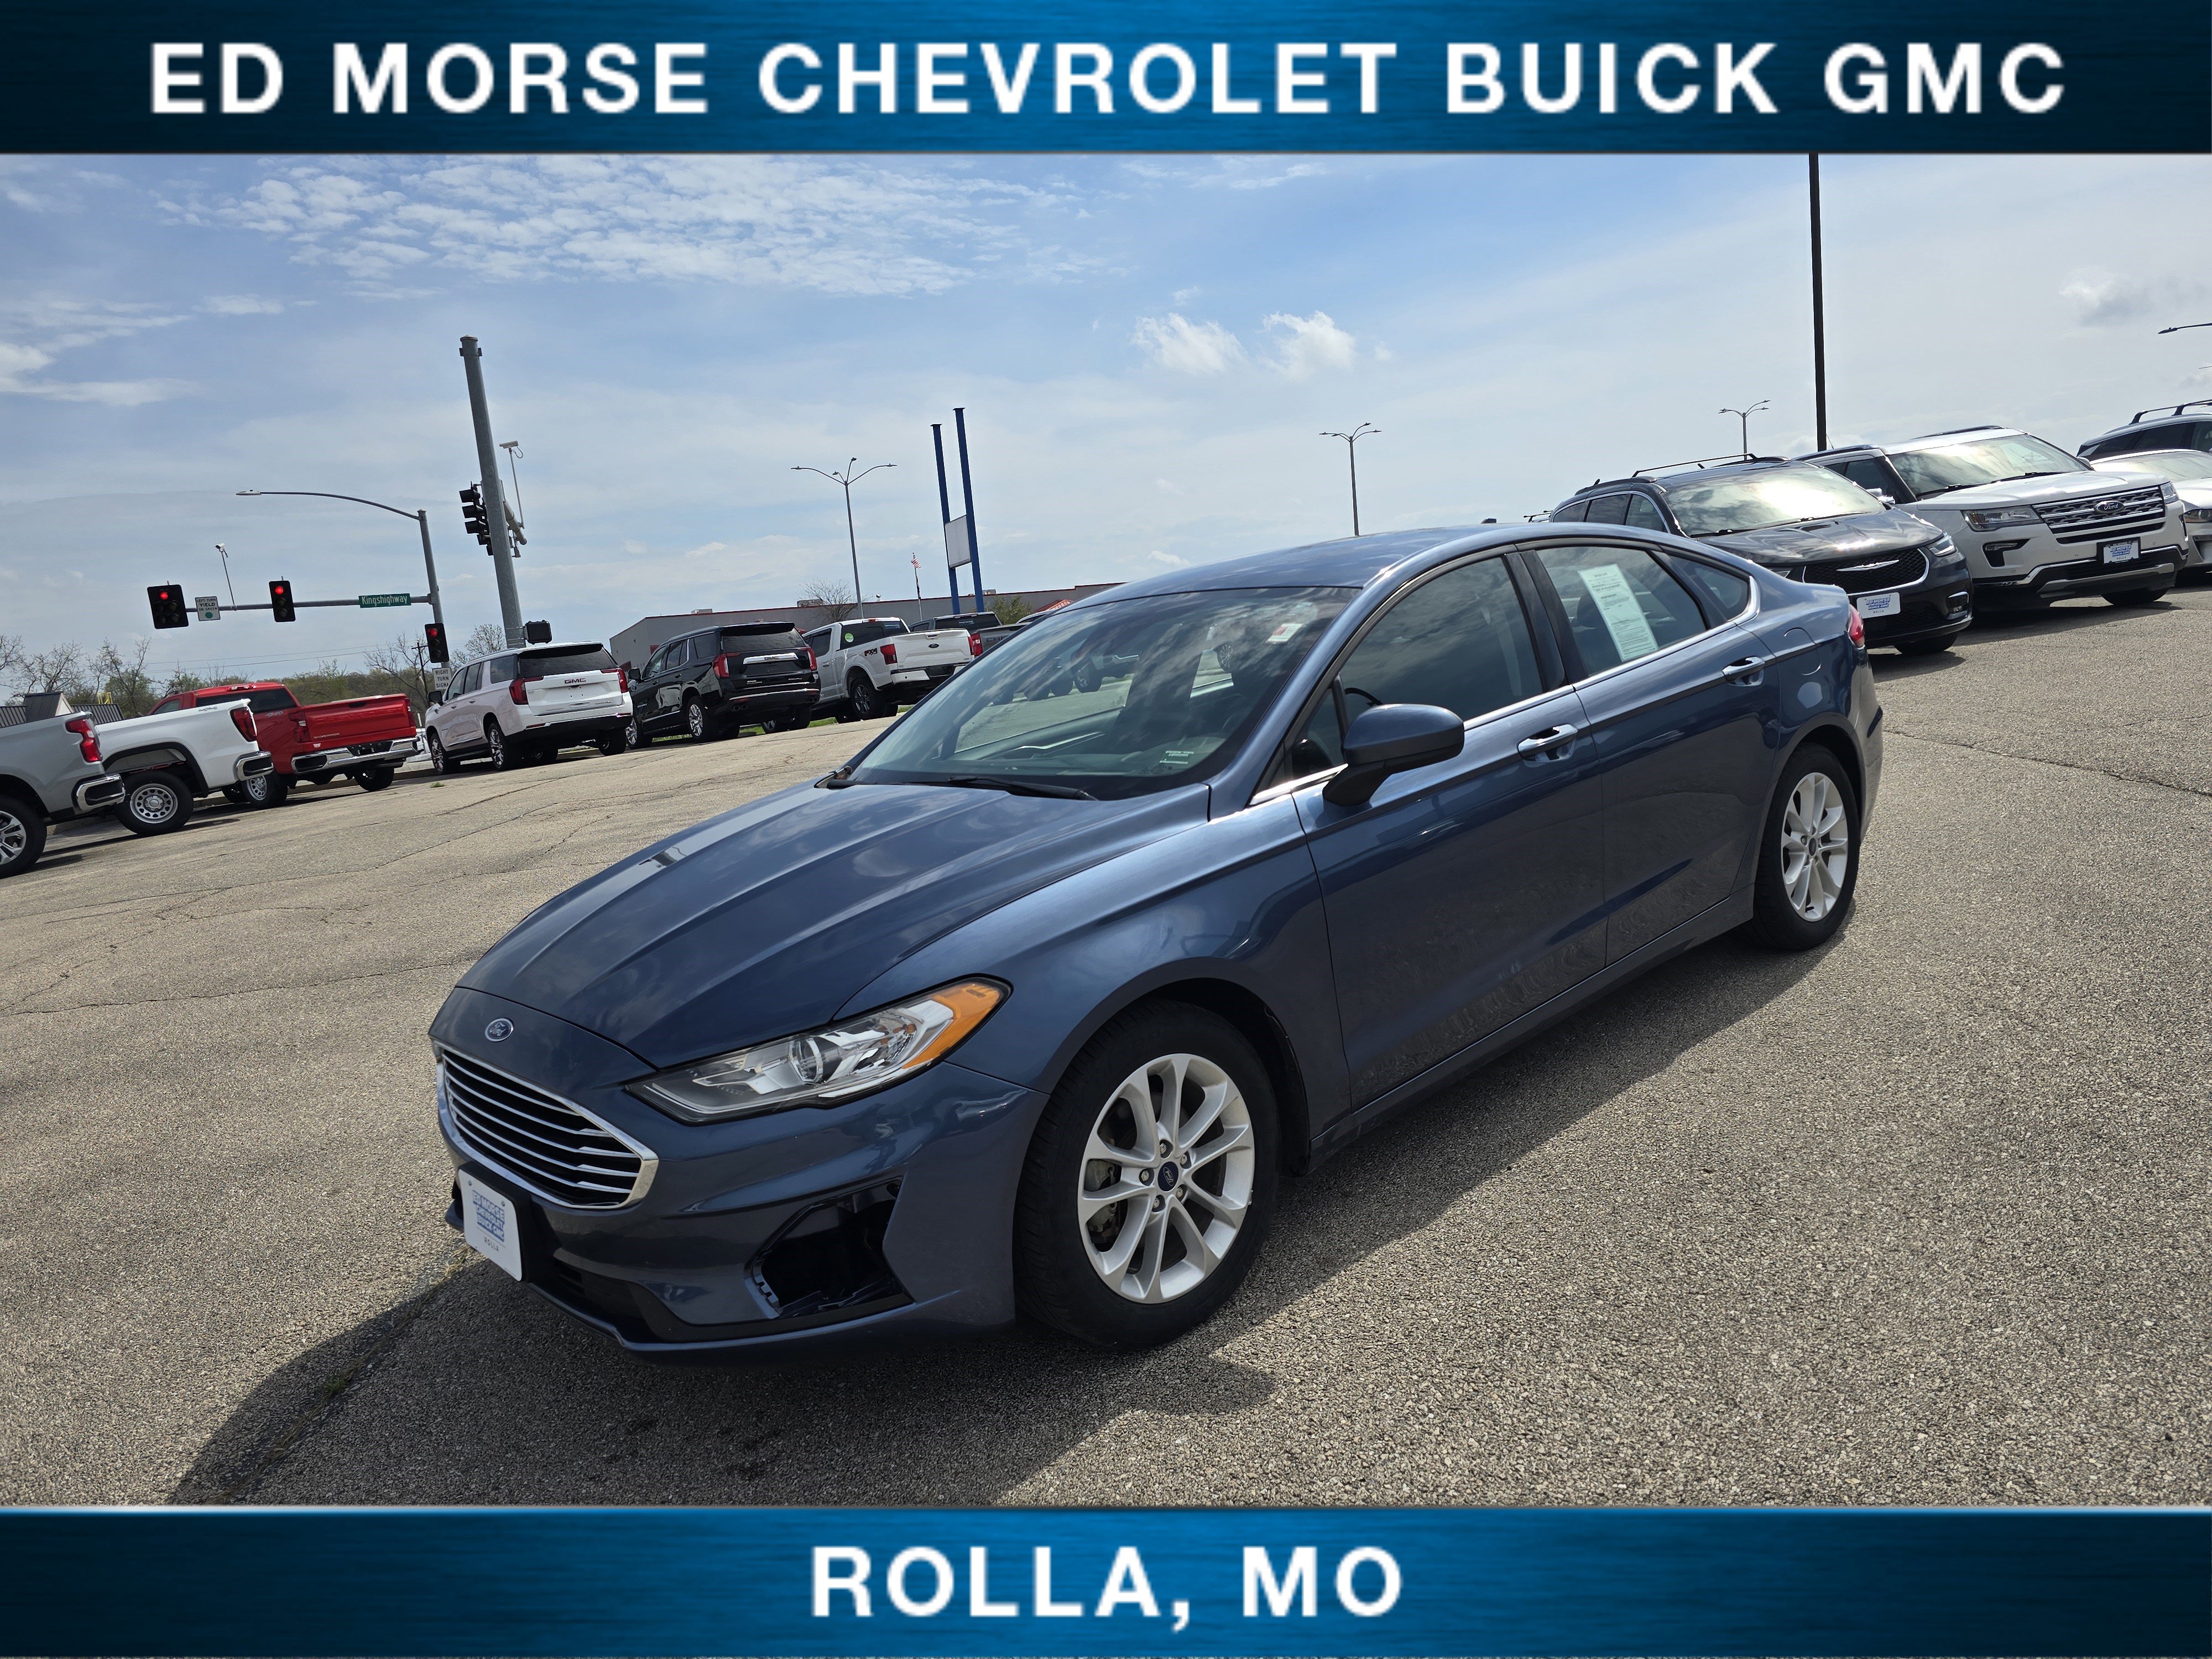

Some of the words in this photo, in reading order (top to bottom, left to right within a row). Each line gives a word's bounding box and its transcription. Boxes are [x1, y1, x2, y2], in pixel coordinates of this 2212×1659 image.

[361, 595, 408, 607] Kingshighway
[489, 1022, 507, 1036] Ford
[484, 1237, 499, 1252] ROLLA
